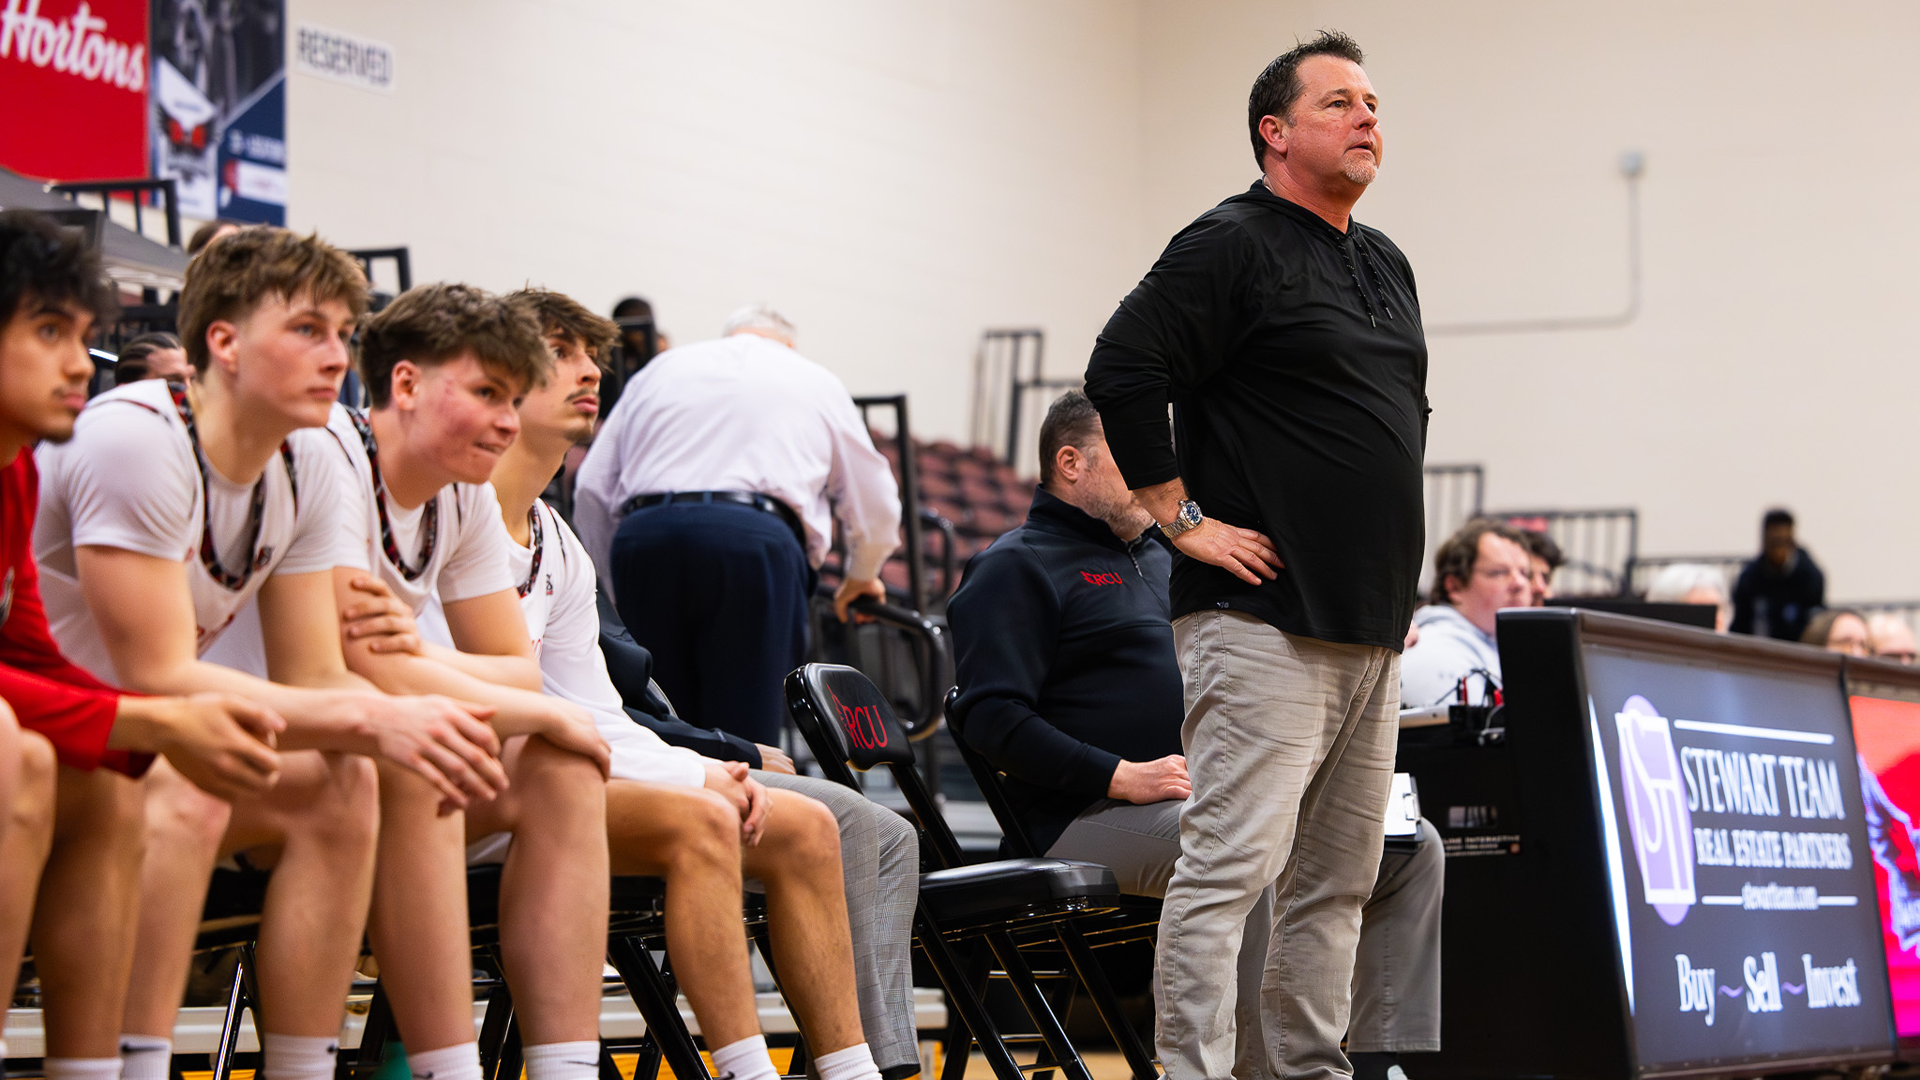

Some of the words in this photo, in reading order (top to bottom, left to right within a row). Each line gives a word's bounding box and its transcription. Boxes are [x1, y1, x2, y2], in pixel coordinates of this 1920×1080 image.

[0, 0, 145, 93] Hortons
[297, 27, 392, 86] RESERVED
[1089, 572, 1122, 586] RCU
[837, 699, 888, 750] RCU
[1681, 746, 1781, 817] STEWART
[1778, 755, 1846, 820] TEAM
[1694, 828, 1735, 866] REAL
[1731, 829, 1785, 868] ESTATE
[1781, 831, 1853, 870] PARTNERS
[1675, 954, 1716, 1026] Buy
[1743, 952, 1783, 1013] Sell
[1801, 953, 1861, 1009] Invest
